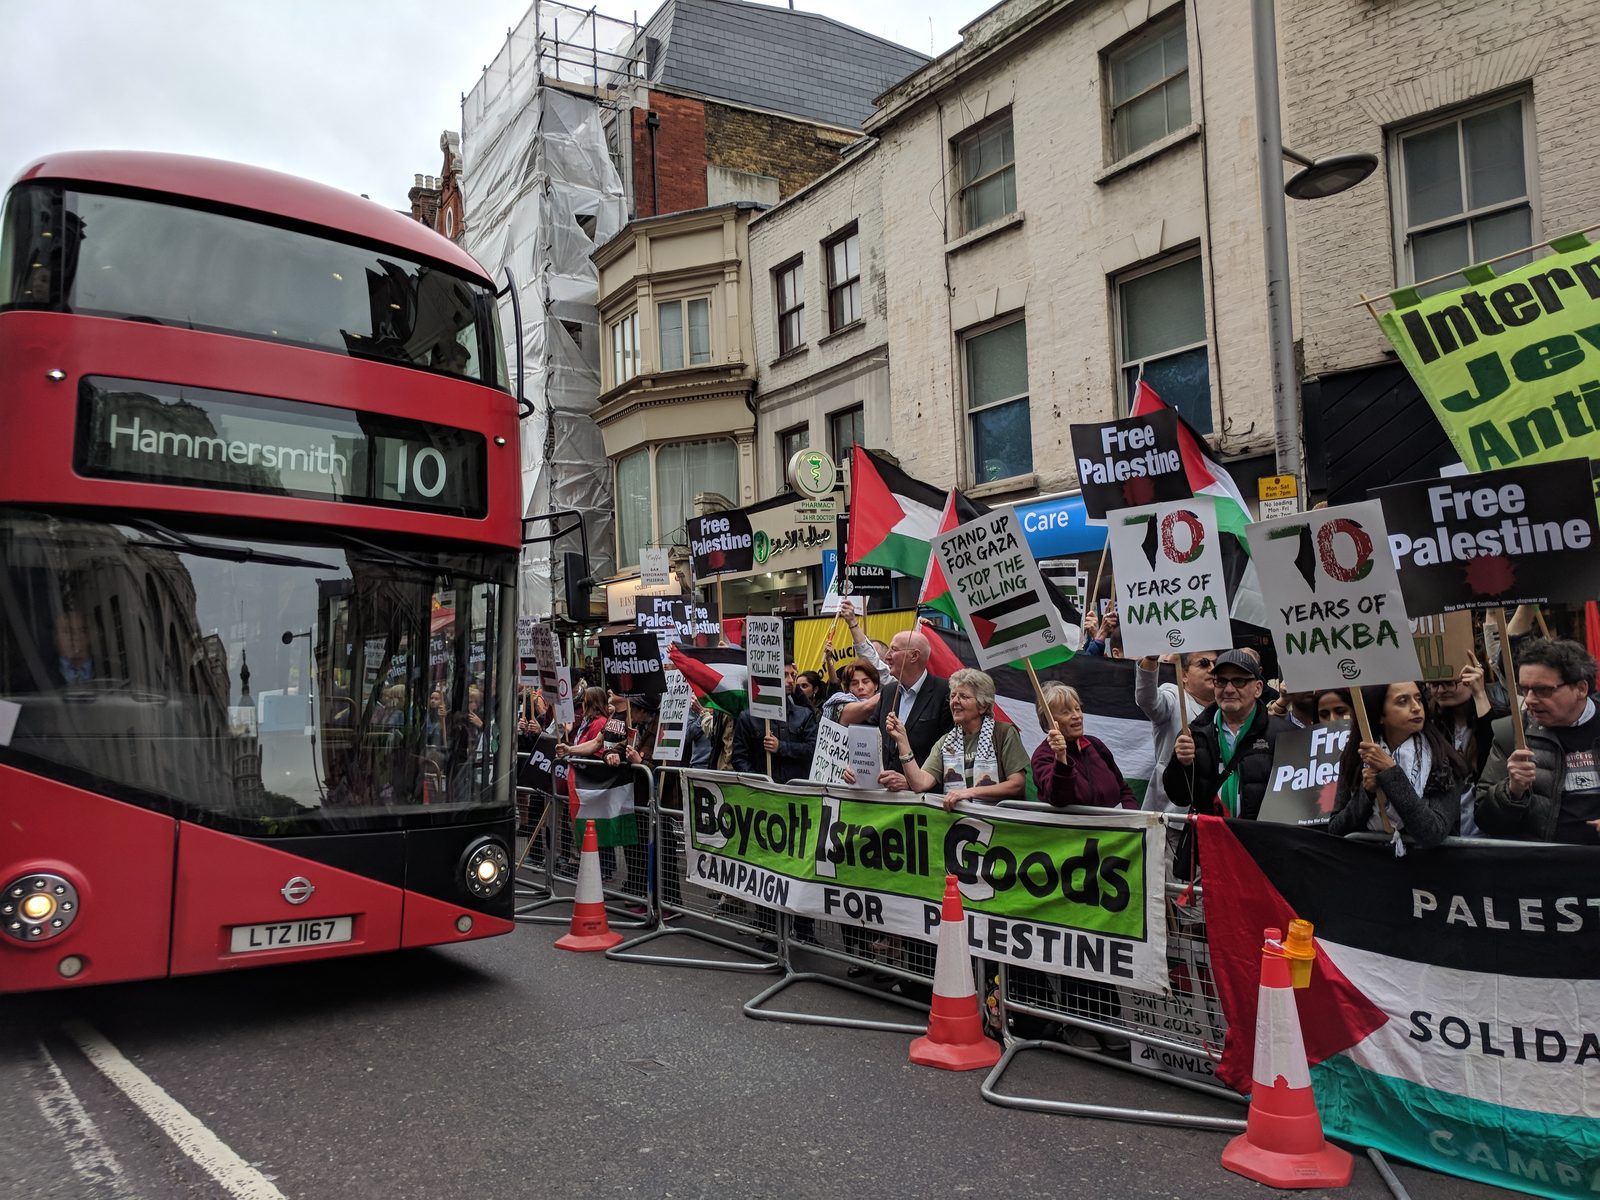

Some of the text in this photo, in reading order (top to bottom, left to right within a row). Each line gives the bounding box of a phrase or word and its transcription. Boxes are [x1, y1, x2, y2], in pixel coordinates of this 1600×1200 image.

[1101, 425, 1155, 455] Free
[110, 414, 447, 498] Hammersmith 10
[1078, 448, 1181, 485] Palestine
[1428, 483, 1526, 524] Free
[700, 517, 730, 537] Free
[1023, 511, 1069, 533] Care
[691, 532, 752, 558] Palestine
[941, 515, 1010, 558] STAND UP
[1387, 517, 1592, 571] Palestine
[946, 533, 1019, 575] FOR GAZA
[845, 566, 884, 576] ON GAZA
[957, 554, 1025, 594] STOP THE
[967, 574, 1028, 608] KILLING
[1126, 574, 1212, 599] YEARS OF
[653, 597, 683, 613] Fre
[684, 605, 708, 620] Free
[1127, 596, 1219, 625] NAKBA
[1280, 594, 1387, 625] YEARS OF
[748, 621, 780, 634] STAND UP
[1285, 619, 1400, 655] NAKBA
[612, 638, 637, 656] Free
[748, 634, 780, 647] FOR GAZA
[603, 656, 660, 675] Palestine
[749, 650, 780, 662] STOP THE
[751, 663, 780, 675] KILLING
[662, 710, 684, 720] KILLING
[663, 698, 687, 710] STOP THE
[821, 724, 840, 742] STAND
[818, 738, 849, 761] FOR GAZA
[816, 755, 829, 770] STOP
[852, 759, 875, 767] APARTHEID
[693, 781, 1131, 913] Boycott Israeli Goods
[697, 853, 1134, 979] CAMPAIGN FOR PLESTINE
[249, 921, 336, 947] LTZ 1167
[1134, 1009, 1158, 1026] THE
[1163, 1017, 1203, 1036] STOP
[1140, 1044, 1214, 1076] STAND UP
[1428, 1129, 1600, 1192] CAMP
